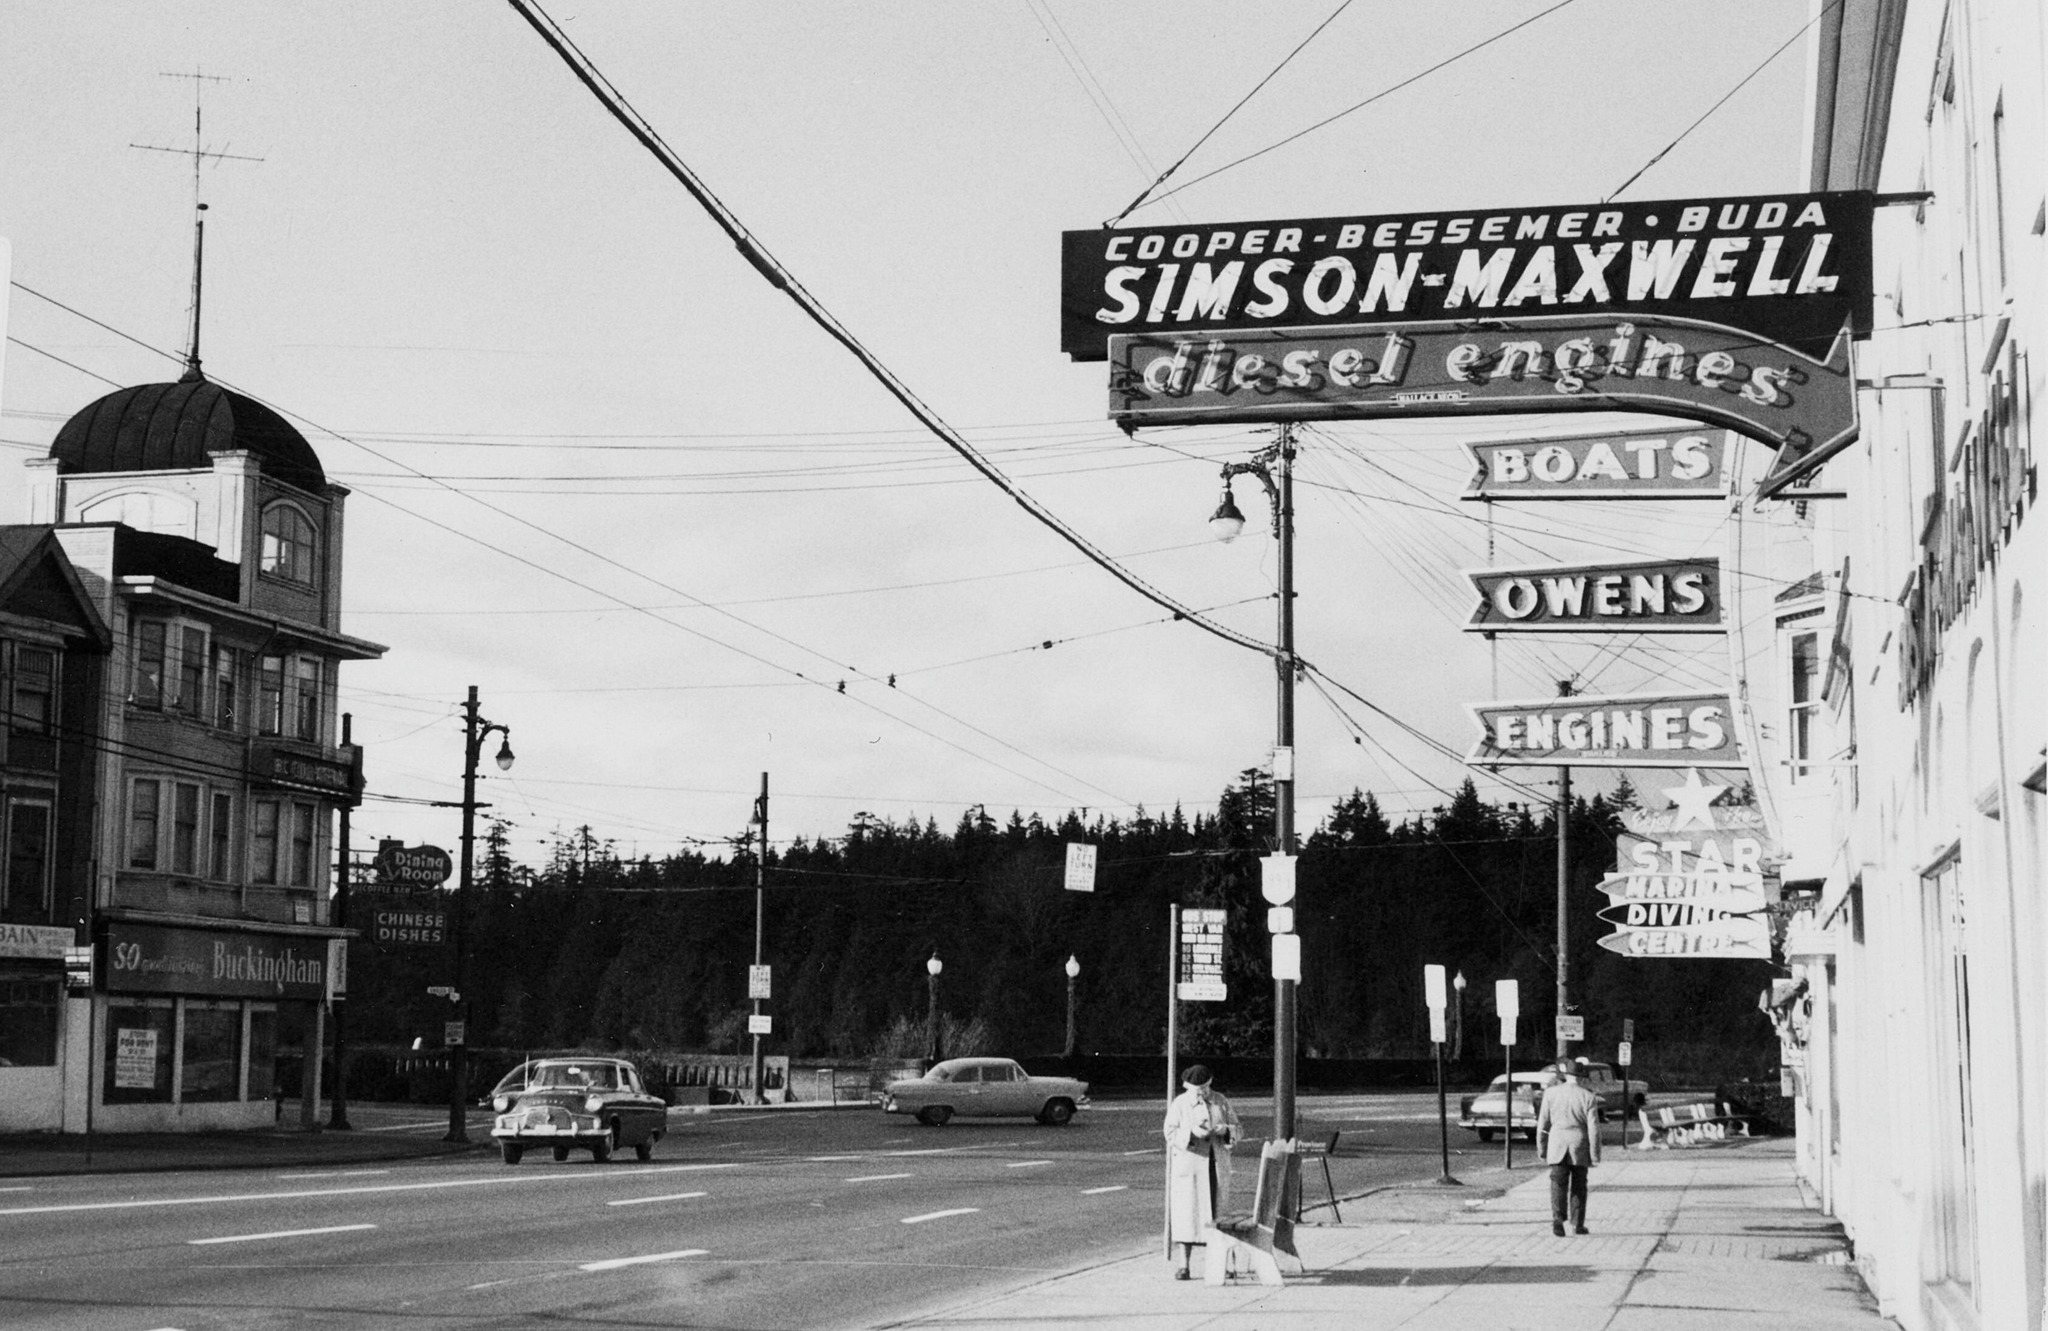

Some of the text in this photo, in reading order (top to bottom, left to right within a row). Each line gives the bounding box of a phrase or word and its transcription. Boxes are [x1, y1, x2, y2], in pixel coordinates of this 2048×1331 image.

[1104, 201, 1826, 261] COOPER-BESSEMER BUDA
[1095, 233, 1839, 323] SIMSON-MAXWELL
[1143, 321, 1791, 406] diesel engines
[1494, 436, 1711, 483] BOATS
[1495, 572, 1706, 620] OWENS
[1497, 705, 1724, 751] ENGINES
[395, 851, 444, 868] Dining
[1070, 861, 1093, 870] TURN
[1071, 853, 1092, 862] LEFT
[1632, 838, 1762, 873] STAR
[402, 866, 444, 882] Room
[378, 912, 444, 928] CHINESE
[1202, 909, 1225, 923] STOP
[1627, 903, 1732, 927] DIVING
[379, 928, 442, 943] DISHES
[1629, 931, 1733, 955] CENTRE
[213, 940, 321, 995] Buckingham
